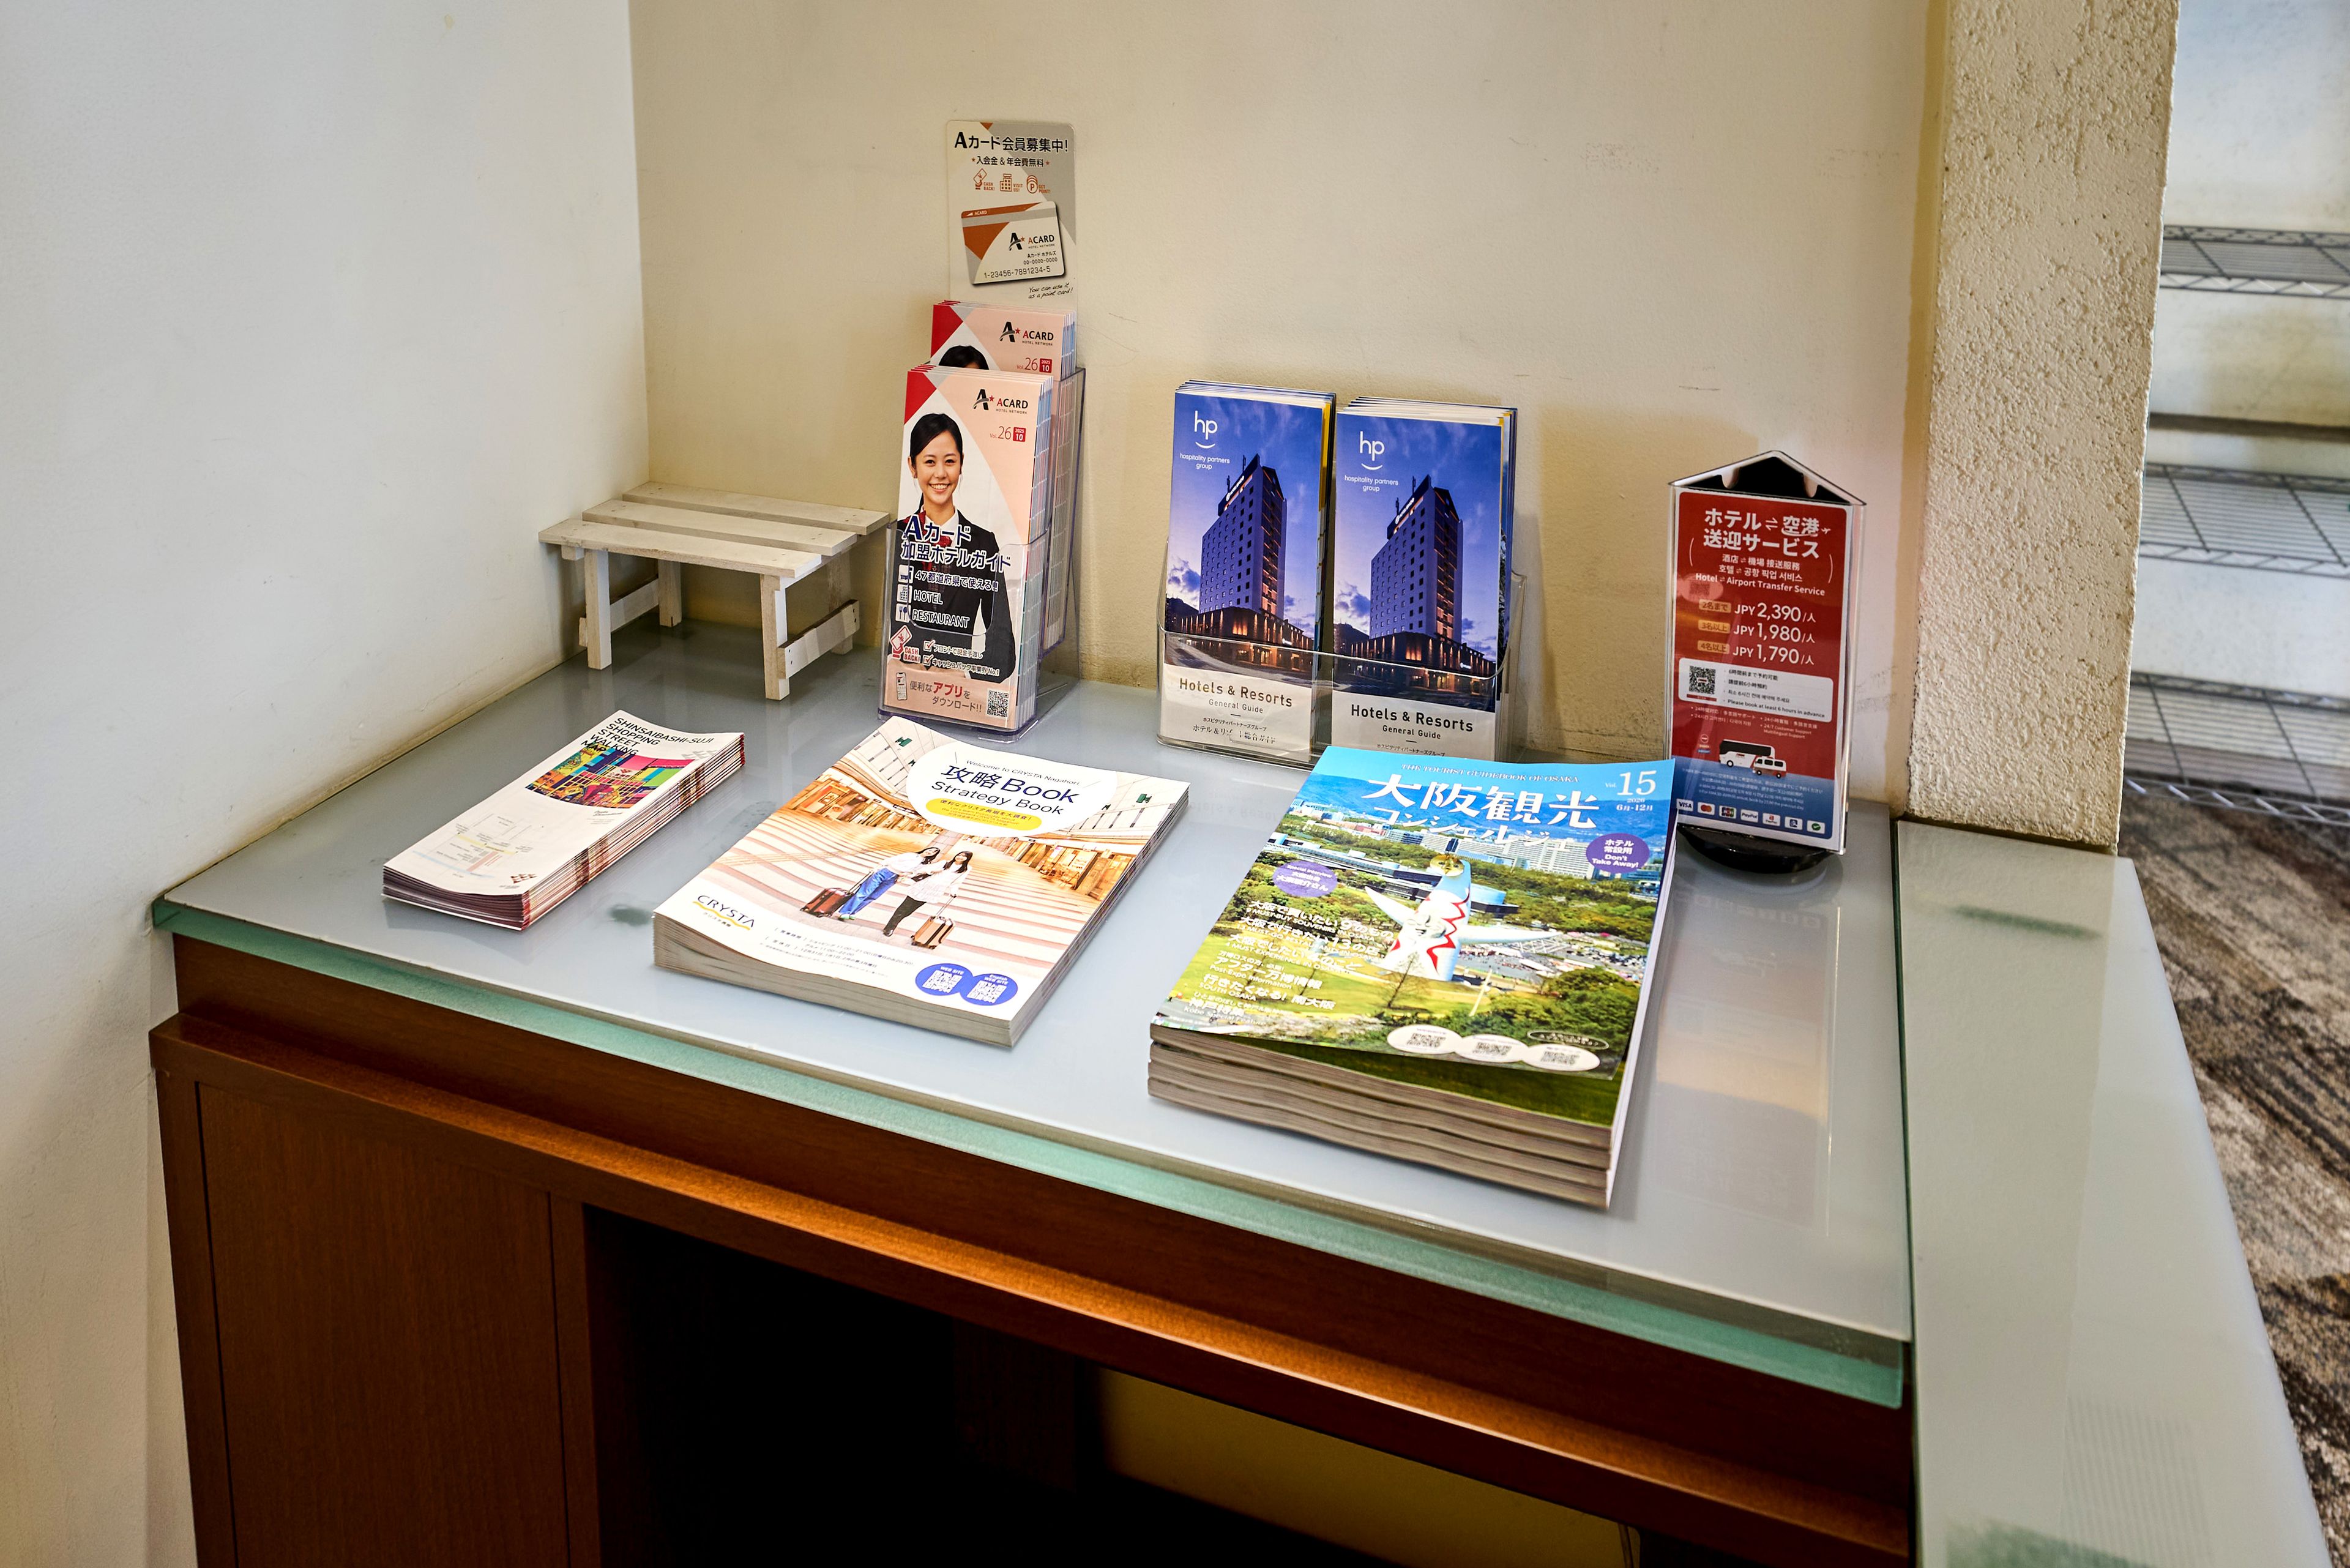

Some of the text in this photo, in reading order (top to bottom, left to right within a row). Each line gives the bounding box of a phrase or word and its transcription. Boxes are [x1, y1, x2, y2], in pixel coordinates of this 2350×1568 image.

[954, 132, 1069, 152] Aカード会員募集中!
[976, 156, 998, 165] 入会金
[1006, 157, 1044, 167] 年会費無料
[1028, 234, 1054, 244] ACARD
[984, 266, 1051, 278] 1-23456-7891234-5
[1040, 291, 1056, 299] point
[1023, 330, 1054, 341] ACARD
[997, 398, 1028, 409] ACARD
[1194, 411, 1218, 439] hp
[1360, 431, 1385, 461] hp
[1179, 453, 1206, 461] hospitality
[1345, 475, 1373, 485] hospitality
[902, 514, 971, 547] Aカード
[1704, 508, 1819, 536] ホテル 空港
[1703, 528, 1819, 559] 送迎サービス
[900, 542, 1011, 573] 加盟ホテルガイド
[1722, 554, 1800, 571] 酒店 機場 接送服務
[1718, 564, 1803, 582] 호텔 공항 픽업 서비스
[1696, 572, 1825, 596] Hotel Airport Transfer Service
[914, 589, 943, 605] HOTEL
[912, 610, 970, 628] RESTAURANT
[1734, 604, 1755, 616] JPY
[1733, 624, 1755, 637] JPY
[904, 654, 920, 663] BACK!
[905, 647, 919, 655] CASH
[1733, 646, 1753, 657] JPY
[910, 681, 971, 700] 便利なアプリを
[1179, 678, 1292, 707] Hotels & Resorts
[1209, 698, 1264, 714] General Guide
[1351, 704, 1474, 733] Hotels & Resorts
[598, 729, 640, 747] STREET
[606, 723, 660, 745] SHOPPING
[614, 717, 714, 744] SHINSAIBASHI-SUJI
[1382, 725, 1441, 739] General Guide
[581, 740, 606, 752] MAP
[591, 734, 639, 755] WALKING
[966, 760, 999, 770] Welcome
[1012, 769, 1042, 778] CRYSTA
[1044, 775, 1080, 786] Nagahori
[1423, 766, 1465, 775] TOURIST
[1467, 770, 1526, 781] GUIDEBOOK
[931, 781, 1064, 815] Strategy Book
[1361, 773, 1600, 829] 大阪観光
[1373, 807, 1570, 851] コンシェルジュ
[1604, 846, 1633, 854] 常設用
[1252, 908, 1292, 922] MUST-BUY
[1293, 917, 1335, 933] SOUVENIRS
[1349, 931, 1376, 942] OSAKA
[1199, 982, 1256, 1001] SOUTH OSAKA
[1248, 975, 1292, 990] Information
